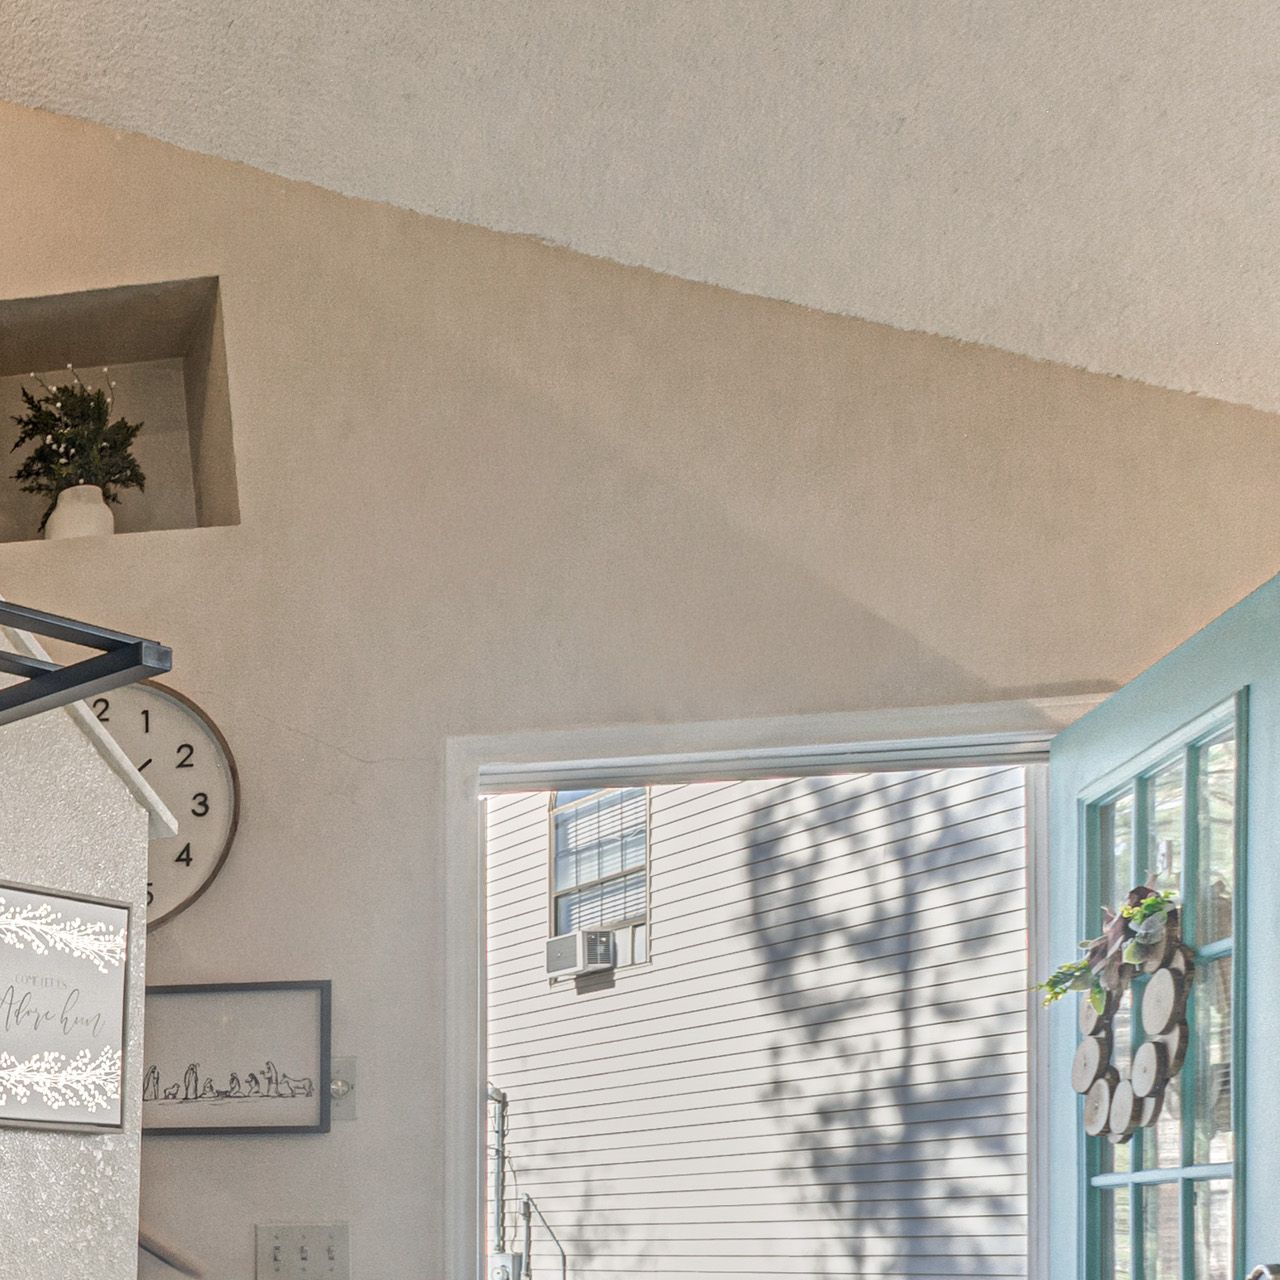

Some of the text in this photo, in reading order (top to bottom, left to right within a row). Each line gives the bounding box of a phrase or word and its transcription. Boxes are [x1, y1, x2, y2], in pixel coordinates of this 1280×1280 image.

[140, 709, 150, 733] 1
[175, 743, 195, 769] 2
[191, 792, 209, 817] 3
[174, 842, 193, 867] 4
